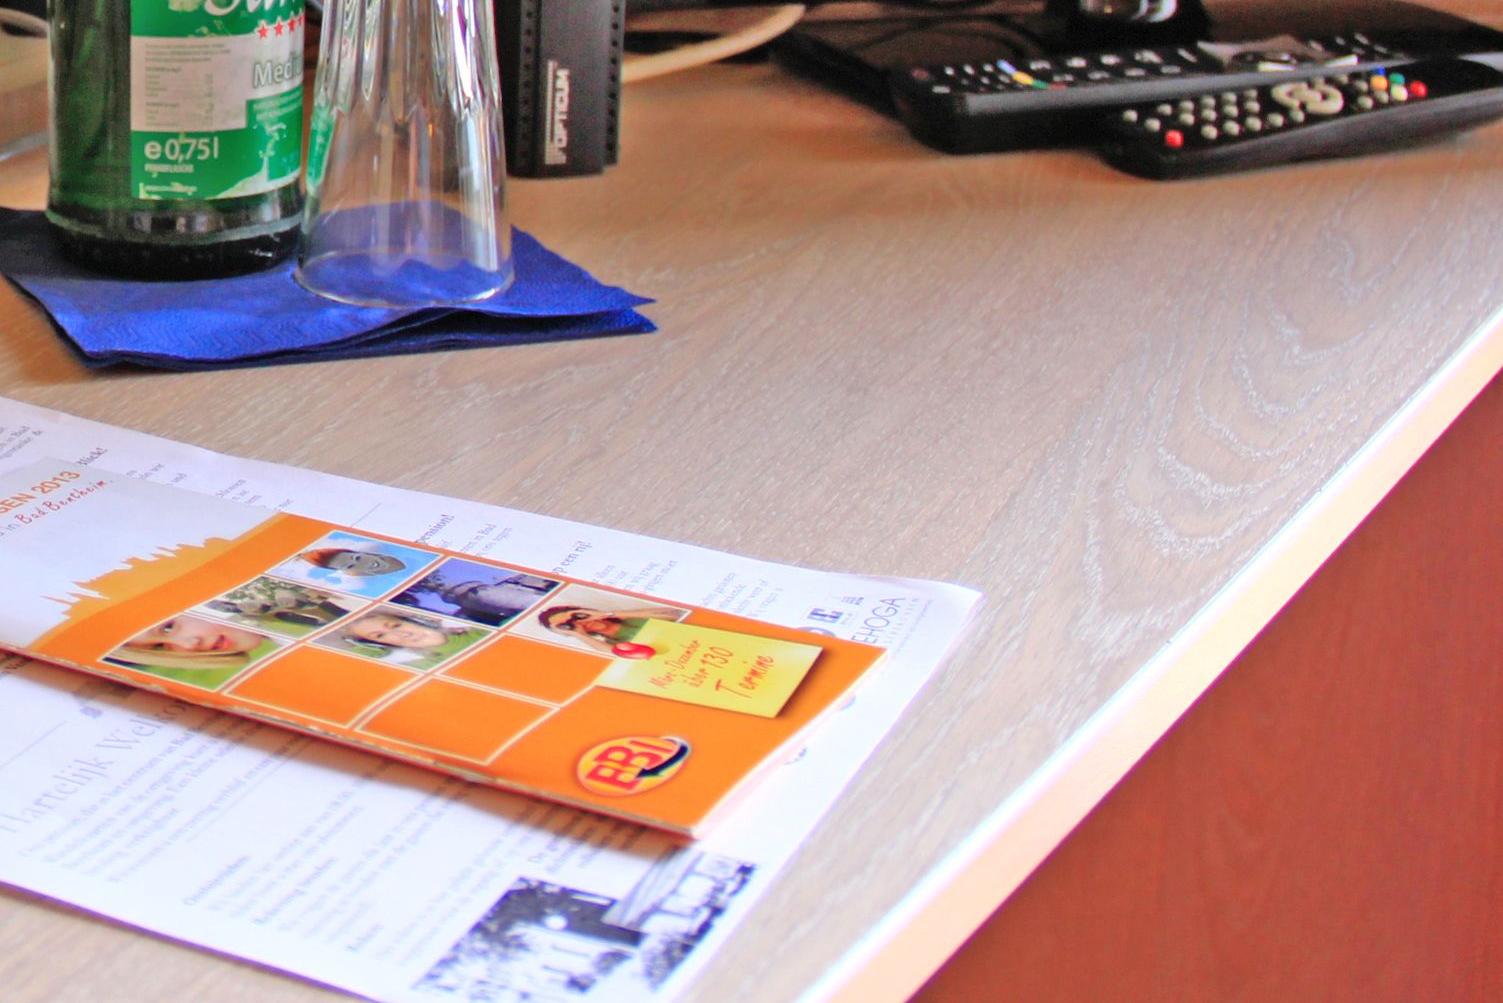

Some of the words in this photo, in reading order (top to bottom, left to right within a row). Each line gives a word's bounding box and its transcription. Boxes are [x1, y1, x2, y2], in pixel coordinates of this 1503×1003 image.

[555, 68, 570, 149] OPTICUM
[31, 470, 81, 495] 2013
[0, 522, 20, 532] in
[14, 506, 48, 525] Bad
[700, 646, 734, 670] 130
[714, 654, 775, 699] Termine
